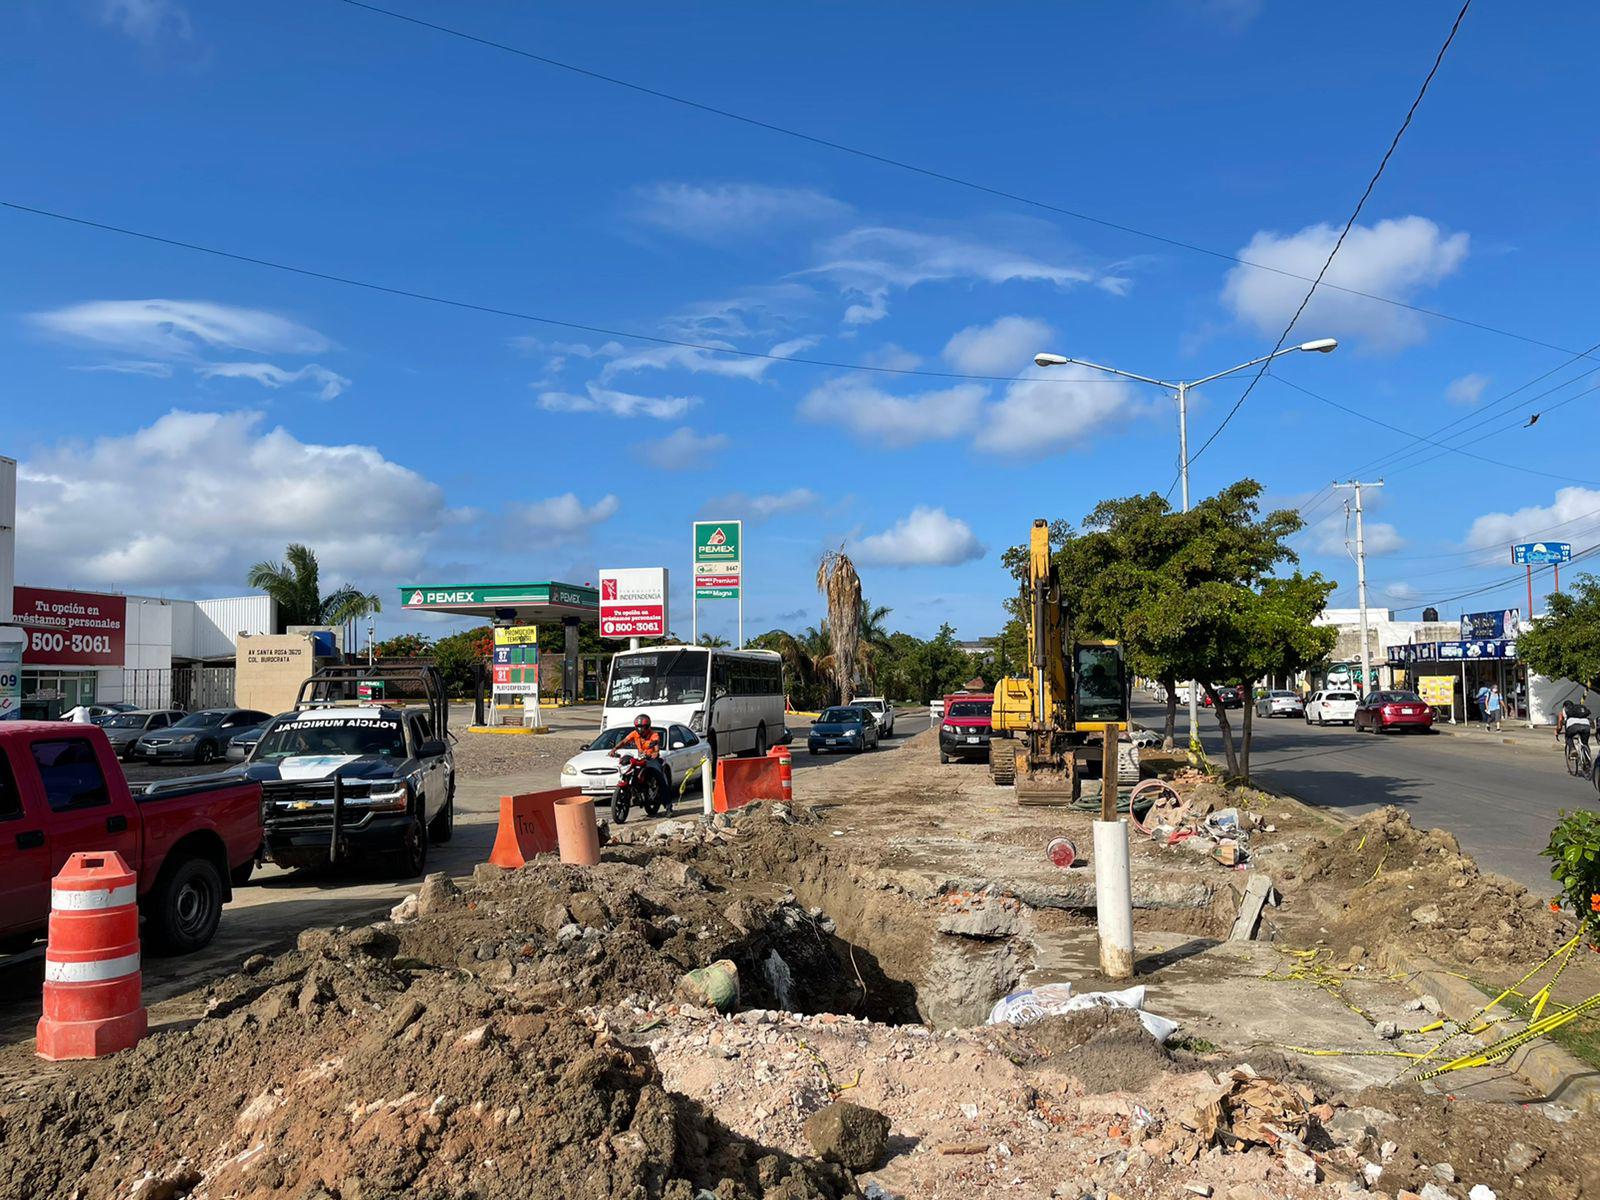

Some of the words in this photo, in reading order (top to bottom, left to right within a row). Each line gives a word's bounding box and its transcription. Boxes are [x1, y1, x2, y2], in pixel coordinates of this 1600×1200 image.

[699, 545, 734, 553] PEMEX
[427, 592, 474, 602] PEMEX
[560, 592, 581, 604] PEMEX
[36, 600, 49, 611] Tu
[52, 602, 85, 614] opción
[87, 606, 100, 615] en
[68, 618, 120, 628] personales
[616, 622, 659, 632] 500-3061
[504, 628, 534, 637] PROMOCIÓN
[32, 632, 112, 653] 500-3061
[498, 652, 507, 660] 87
[498, 670, 506, 679] 91
